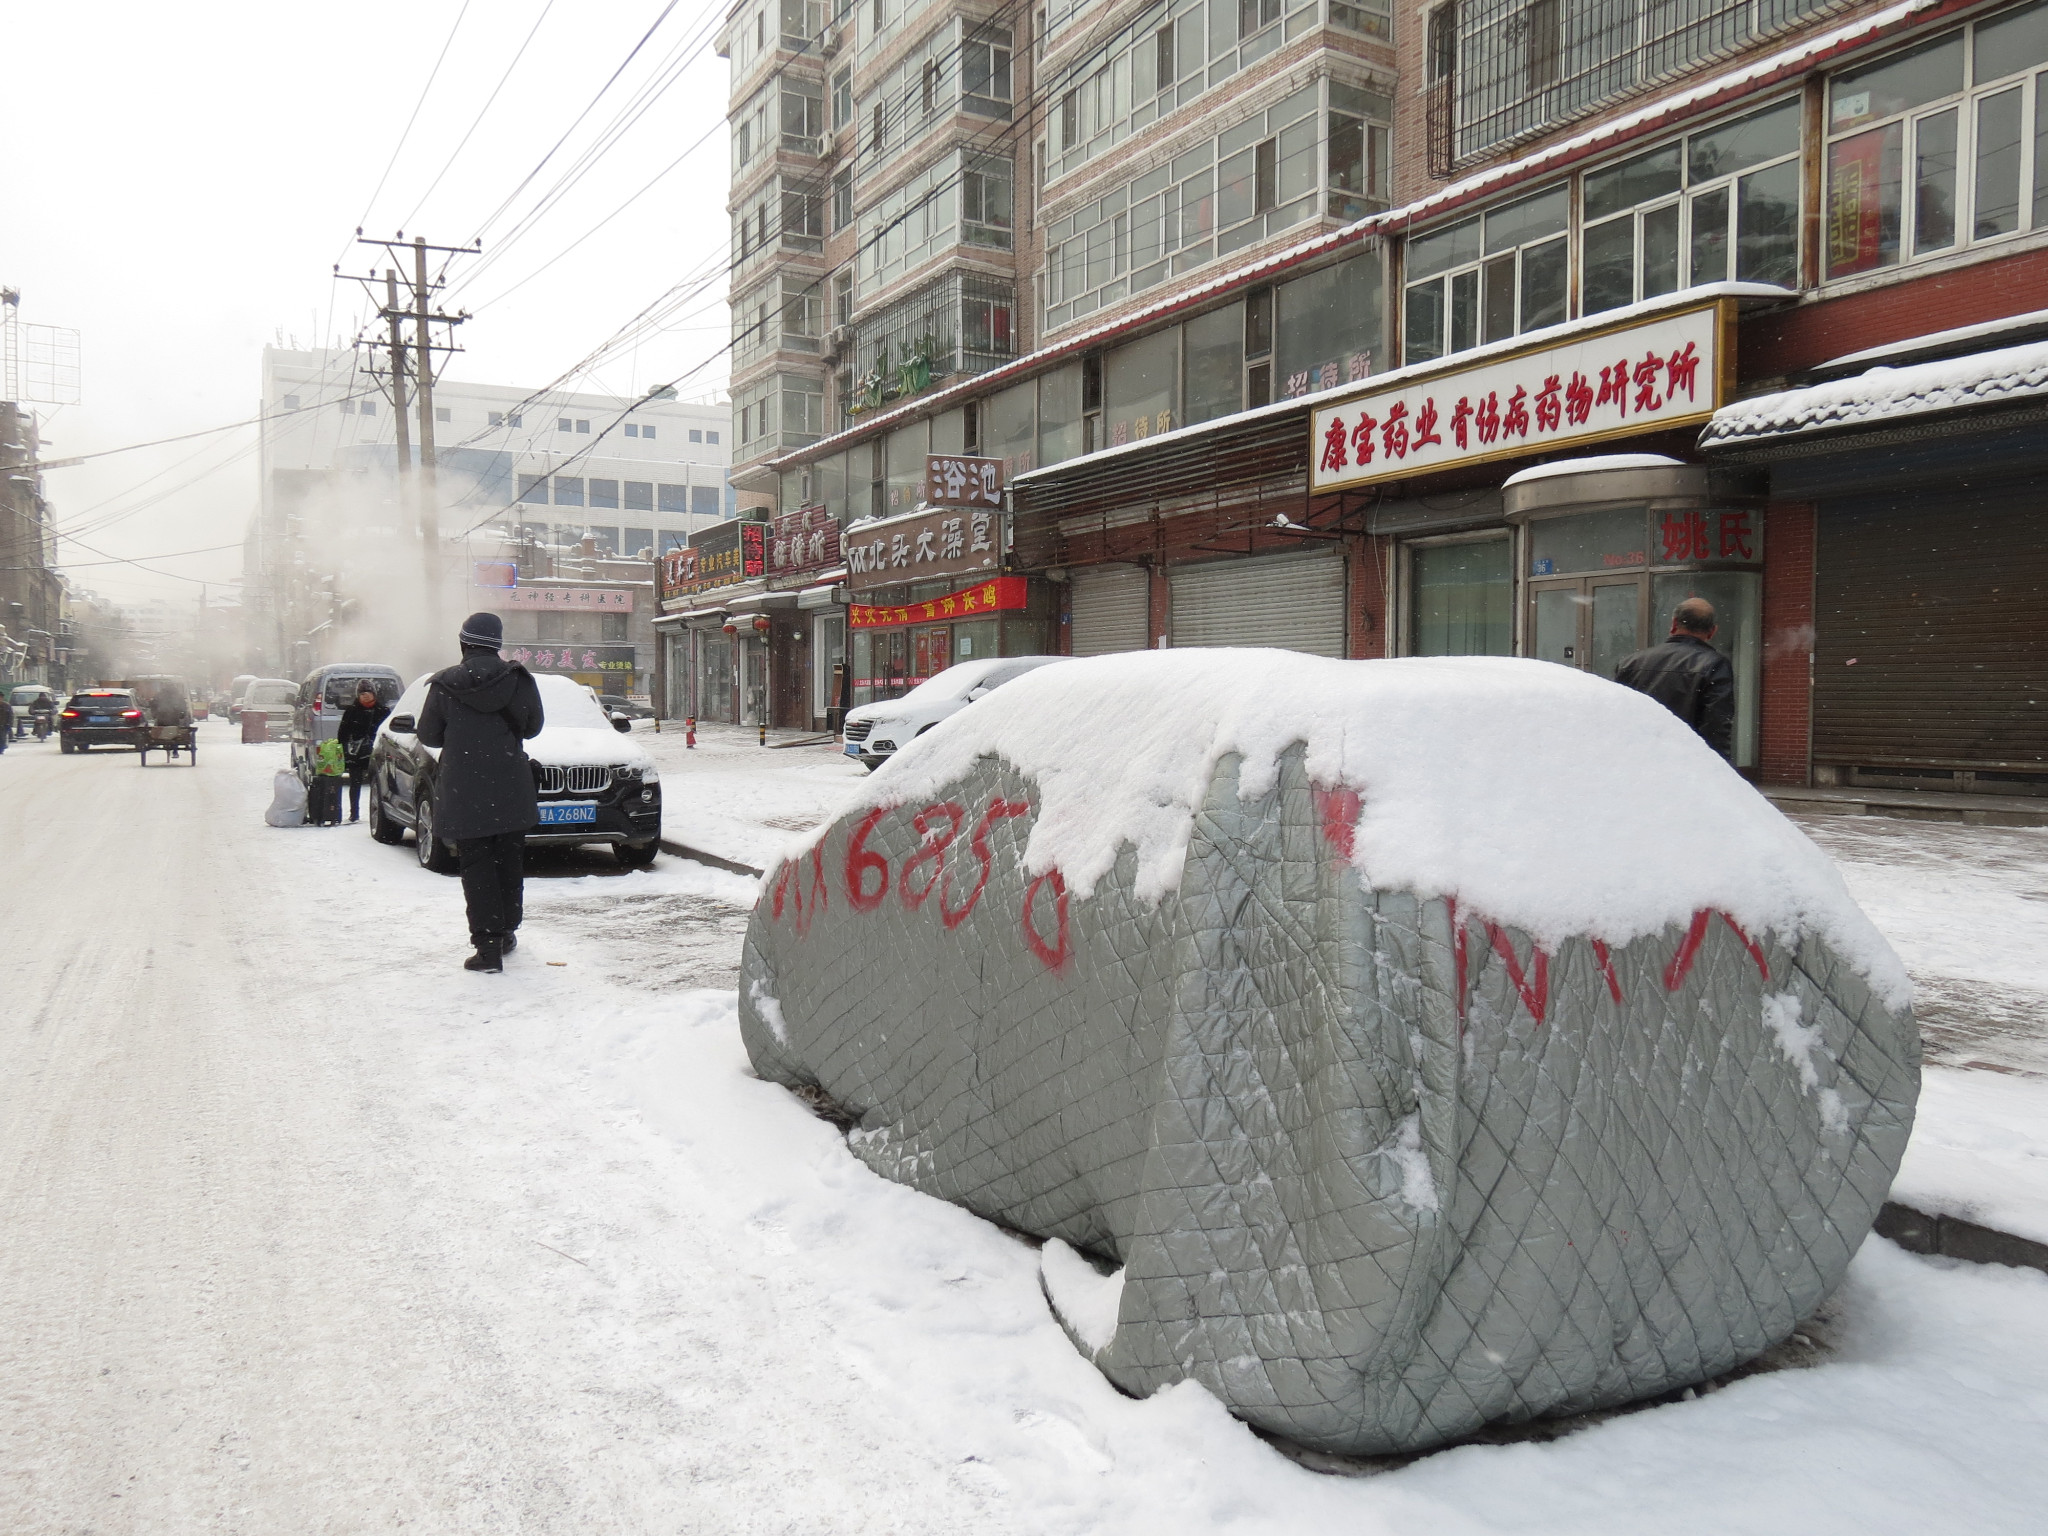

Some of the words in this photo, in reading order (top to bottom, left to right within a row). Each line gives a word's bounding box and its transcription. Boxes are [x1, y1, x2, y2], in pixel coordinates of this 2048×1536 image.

[1287, 350, 1371, 398] 招待所
[1110, 409, 1171, 446] 招待所
[1320, 396, 1442, 473] 康宝药业
[1450, 341, 1700, 451] 骨伤病药物研究所
[931, 460, 1001, 505] 浴池
[743, 524, 764, 577] 招待所
[1661, 511, 1753, 561] 姚氏
[1536, 563, 1546, 573] 36
